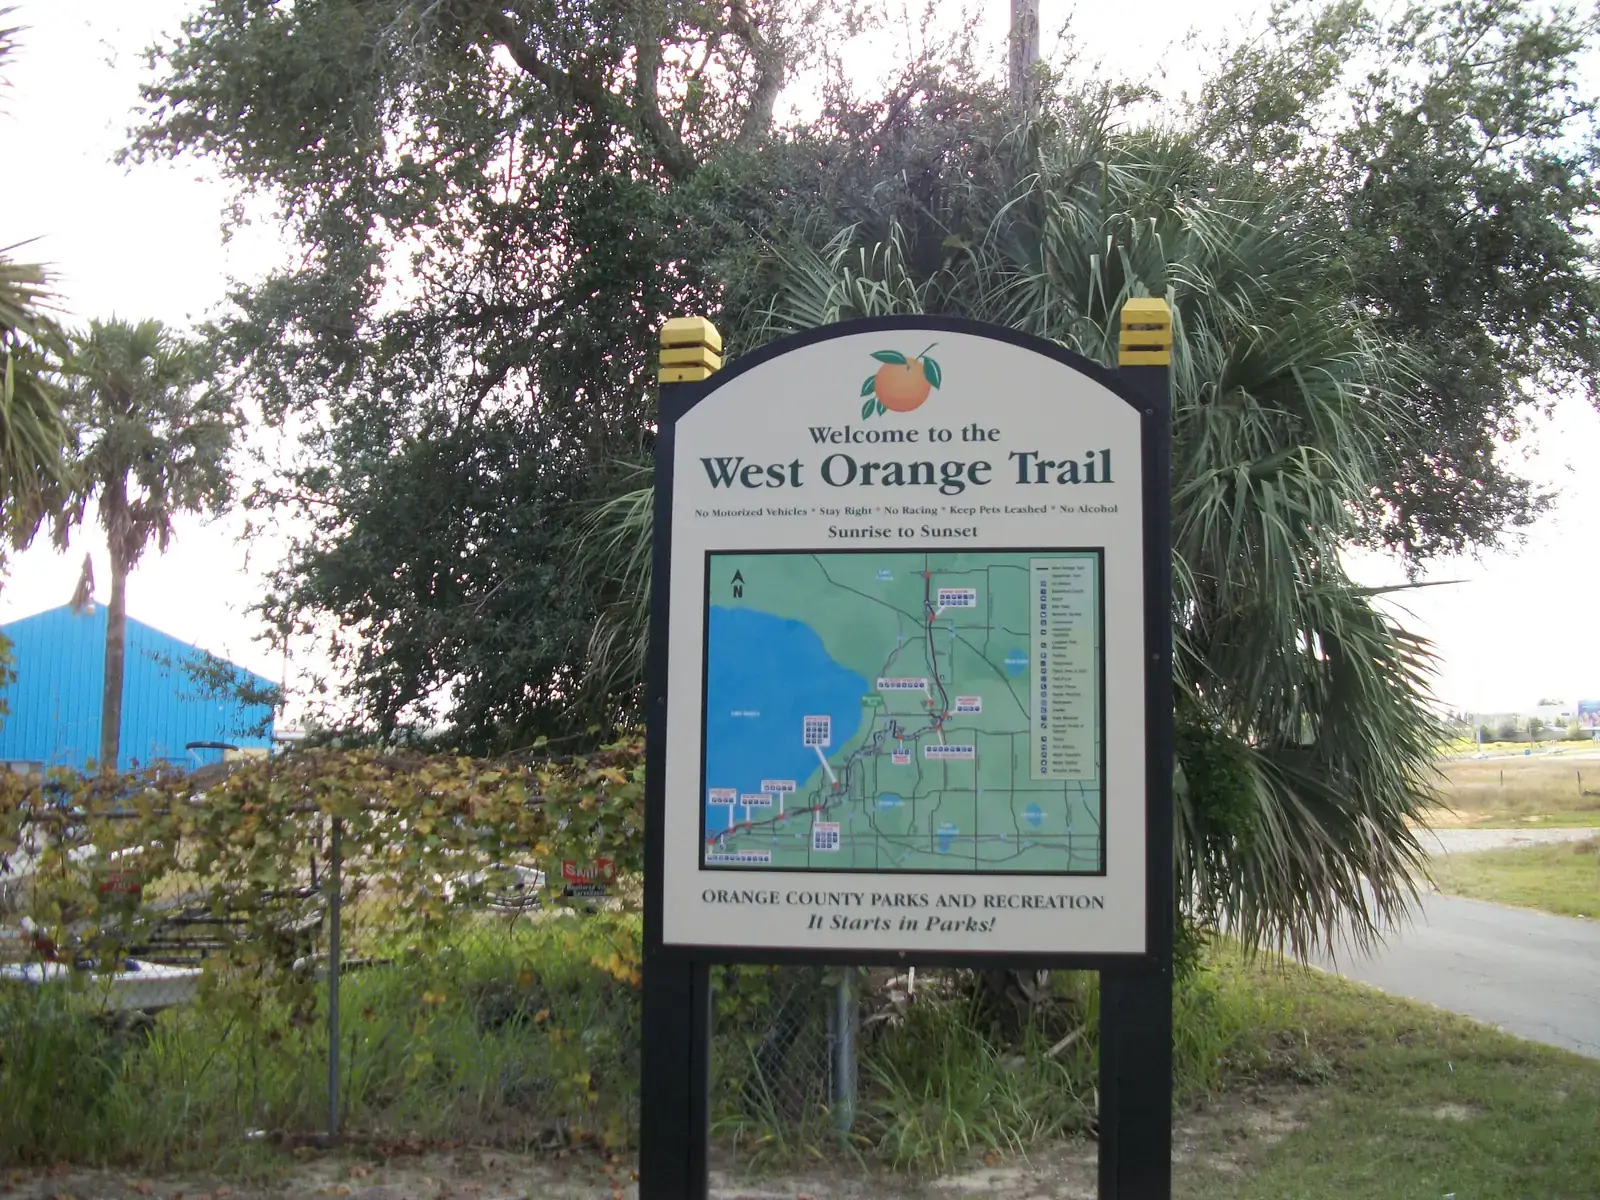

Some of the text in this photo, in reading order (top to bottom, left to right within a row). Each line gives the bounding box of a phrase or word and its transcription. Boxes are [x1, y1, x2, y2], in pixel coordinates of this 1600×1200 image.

[808, 422, 1001, 445] Welcome to the
[699, 448, 1115, 496] West Orange Trail
[695, 504, 1118, 518] No Motorized Vehicles Stay Right No Racing Keep Pets Leashed No Alcohol
[828, 524, 978, 539] Sunrise to Sunset
[733, 585, 743, 598] N
[701, 889, 1105, 910] ORANGE COUNTY PARKS AND RECREATION
[805, 914, 997, 933] It Starts in Parks!
